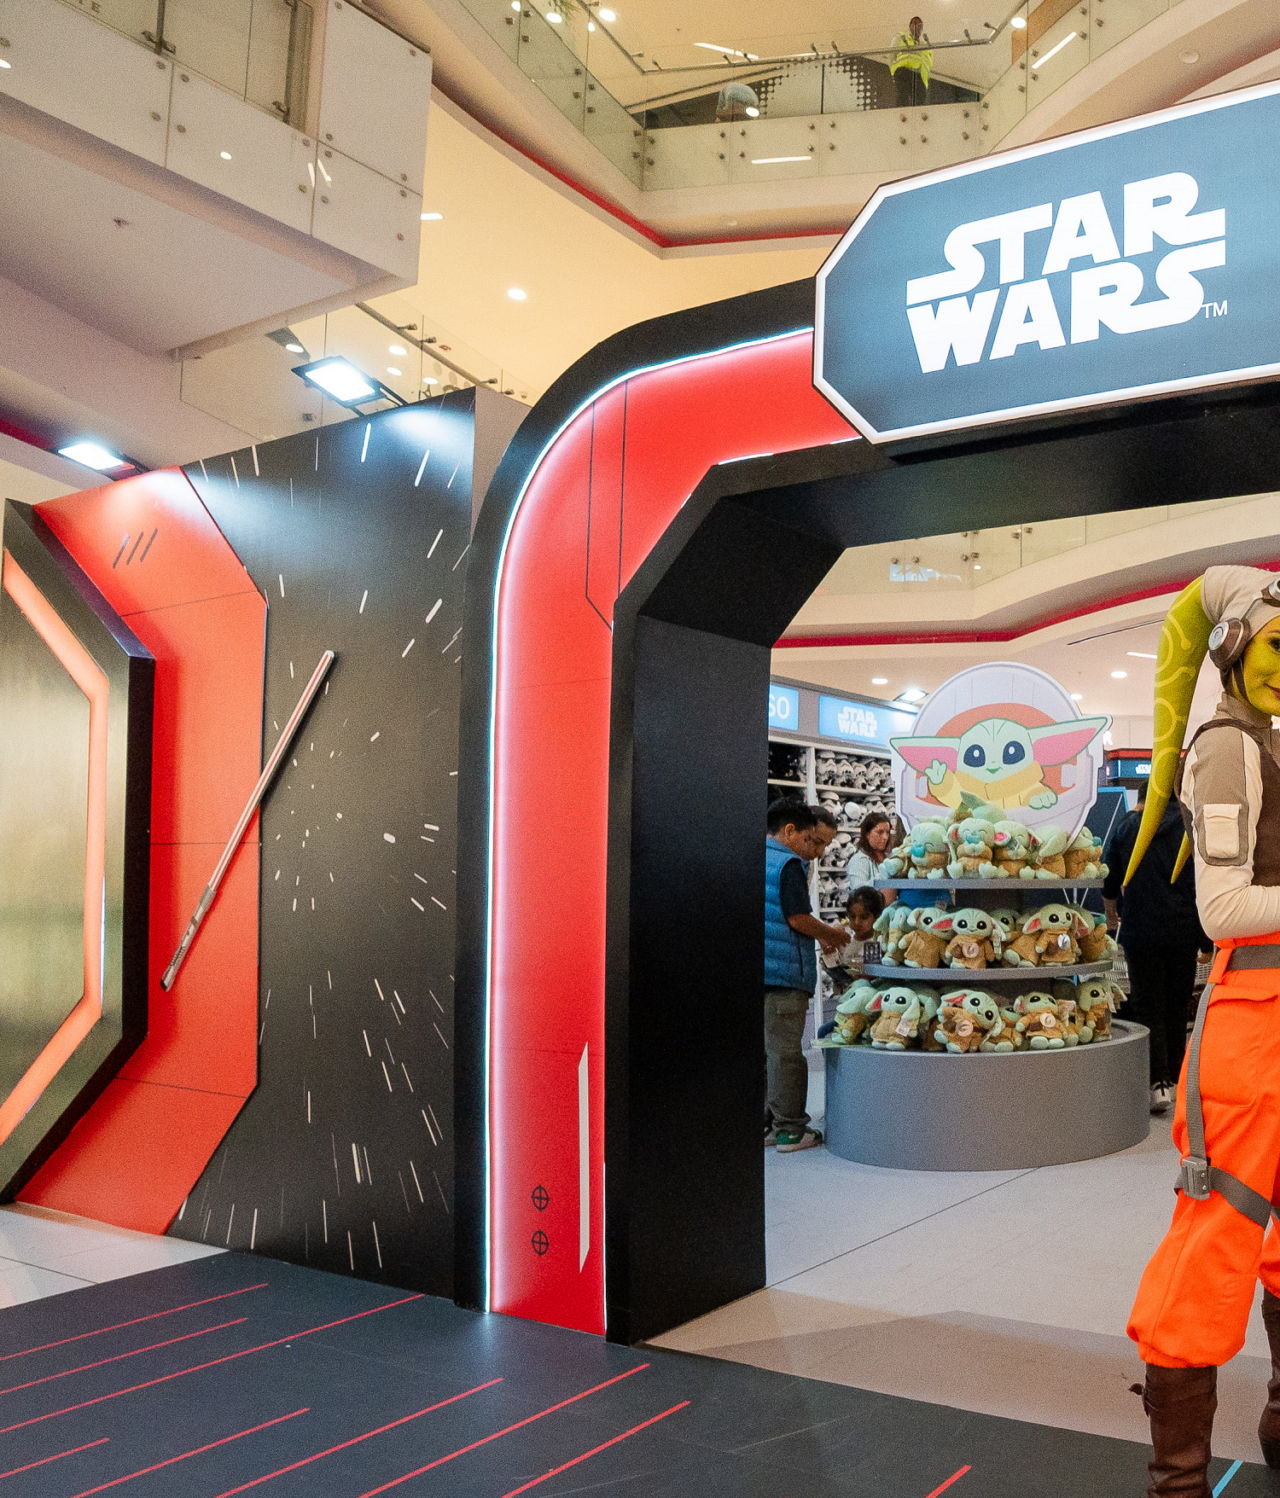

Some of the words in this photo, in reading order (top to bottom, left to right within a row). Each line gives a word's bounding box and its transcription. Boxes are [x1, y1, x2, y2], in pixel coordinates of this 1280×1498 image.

[906, 171, 1226, 306] STAR
[906, 239, 1226, 374] WARS
[1201, 299, 1228, 319] TM
[838, 706, 877, 725] STAR
[838, 719, 878, 738] WARS
